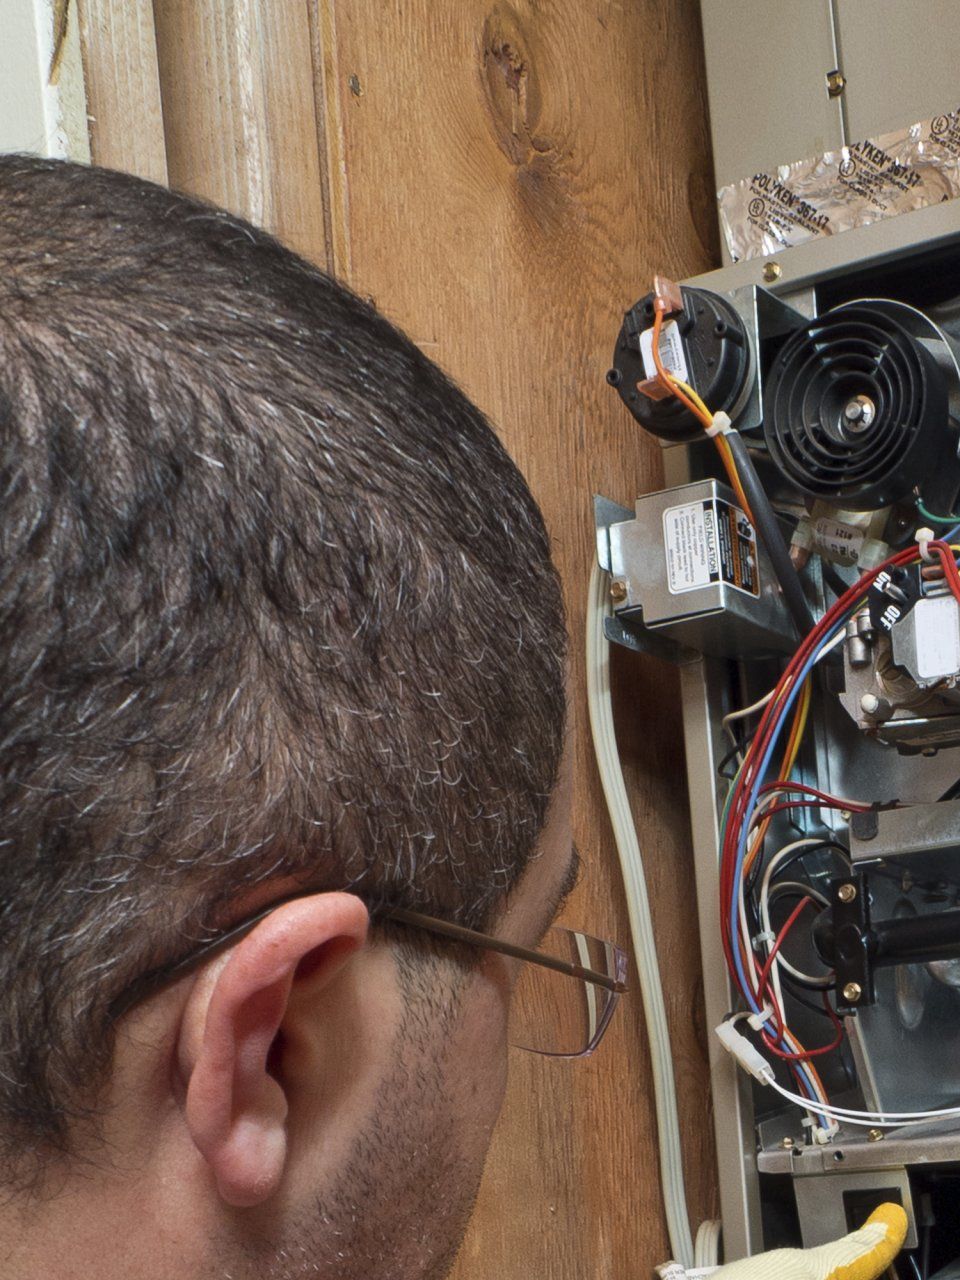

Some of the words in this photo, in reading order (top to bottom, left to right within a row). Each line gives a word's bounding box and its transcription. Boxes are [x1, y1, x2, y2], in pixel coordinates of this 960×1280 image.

[704, 511, 717, 573] INSTALLATION
[873, 571, 892, 593] ON
[879, 605, 901, 631] OFF
